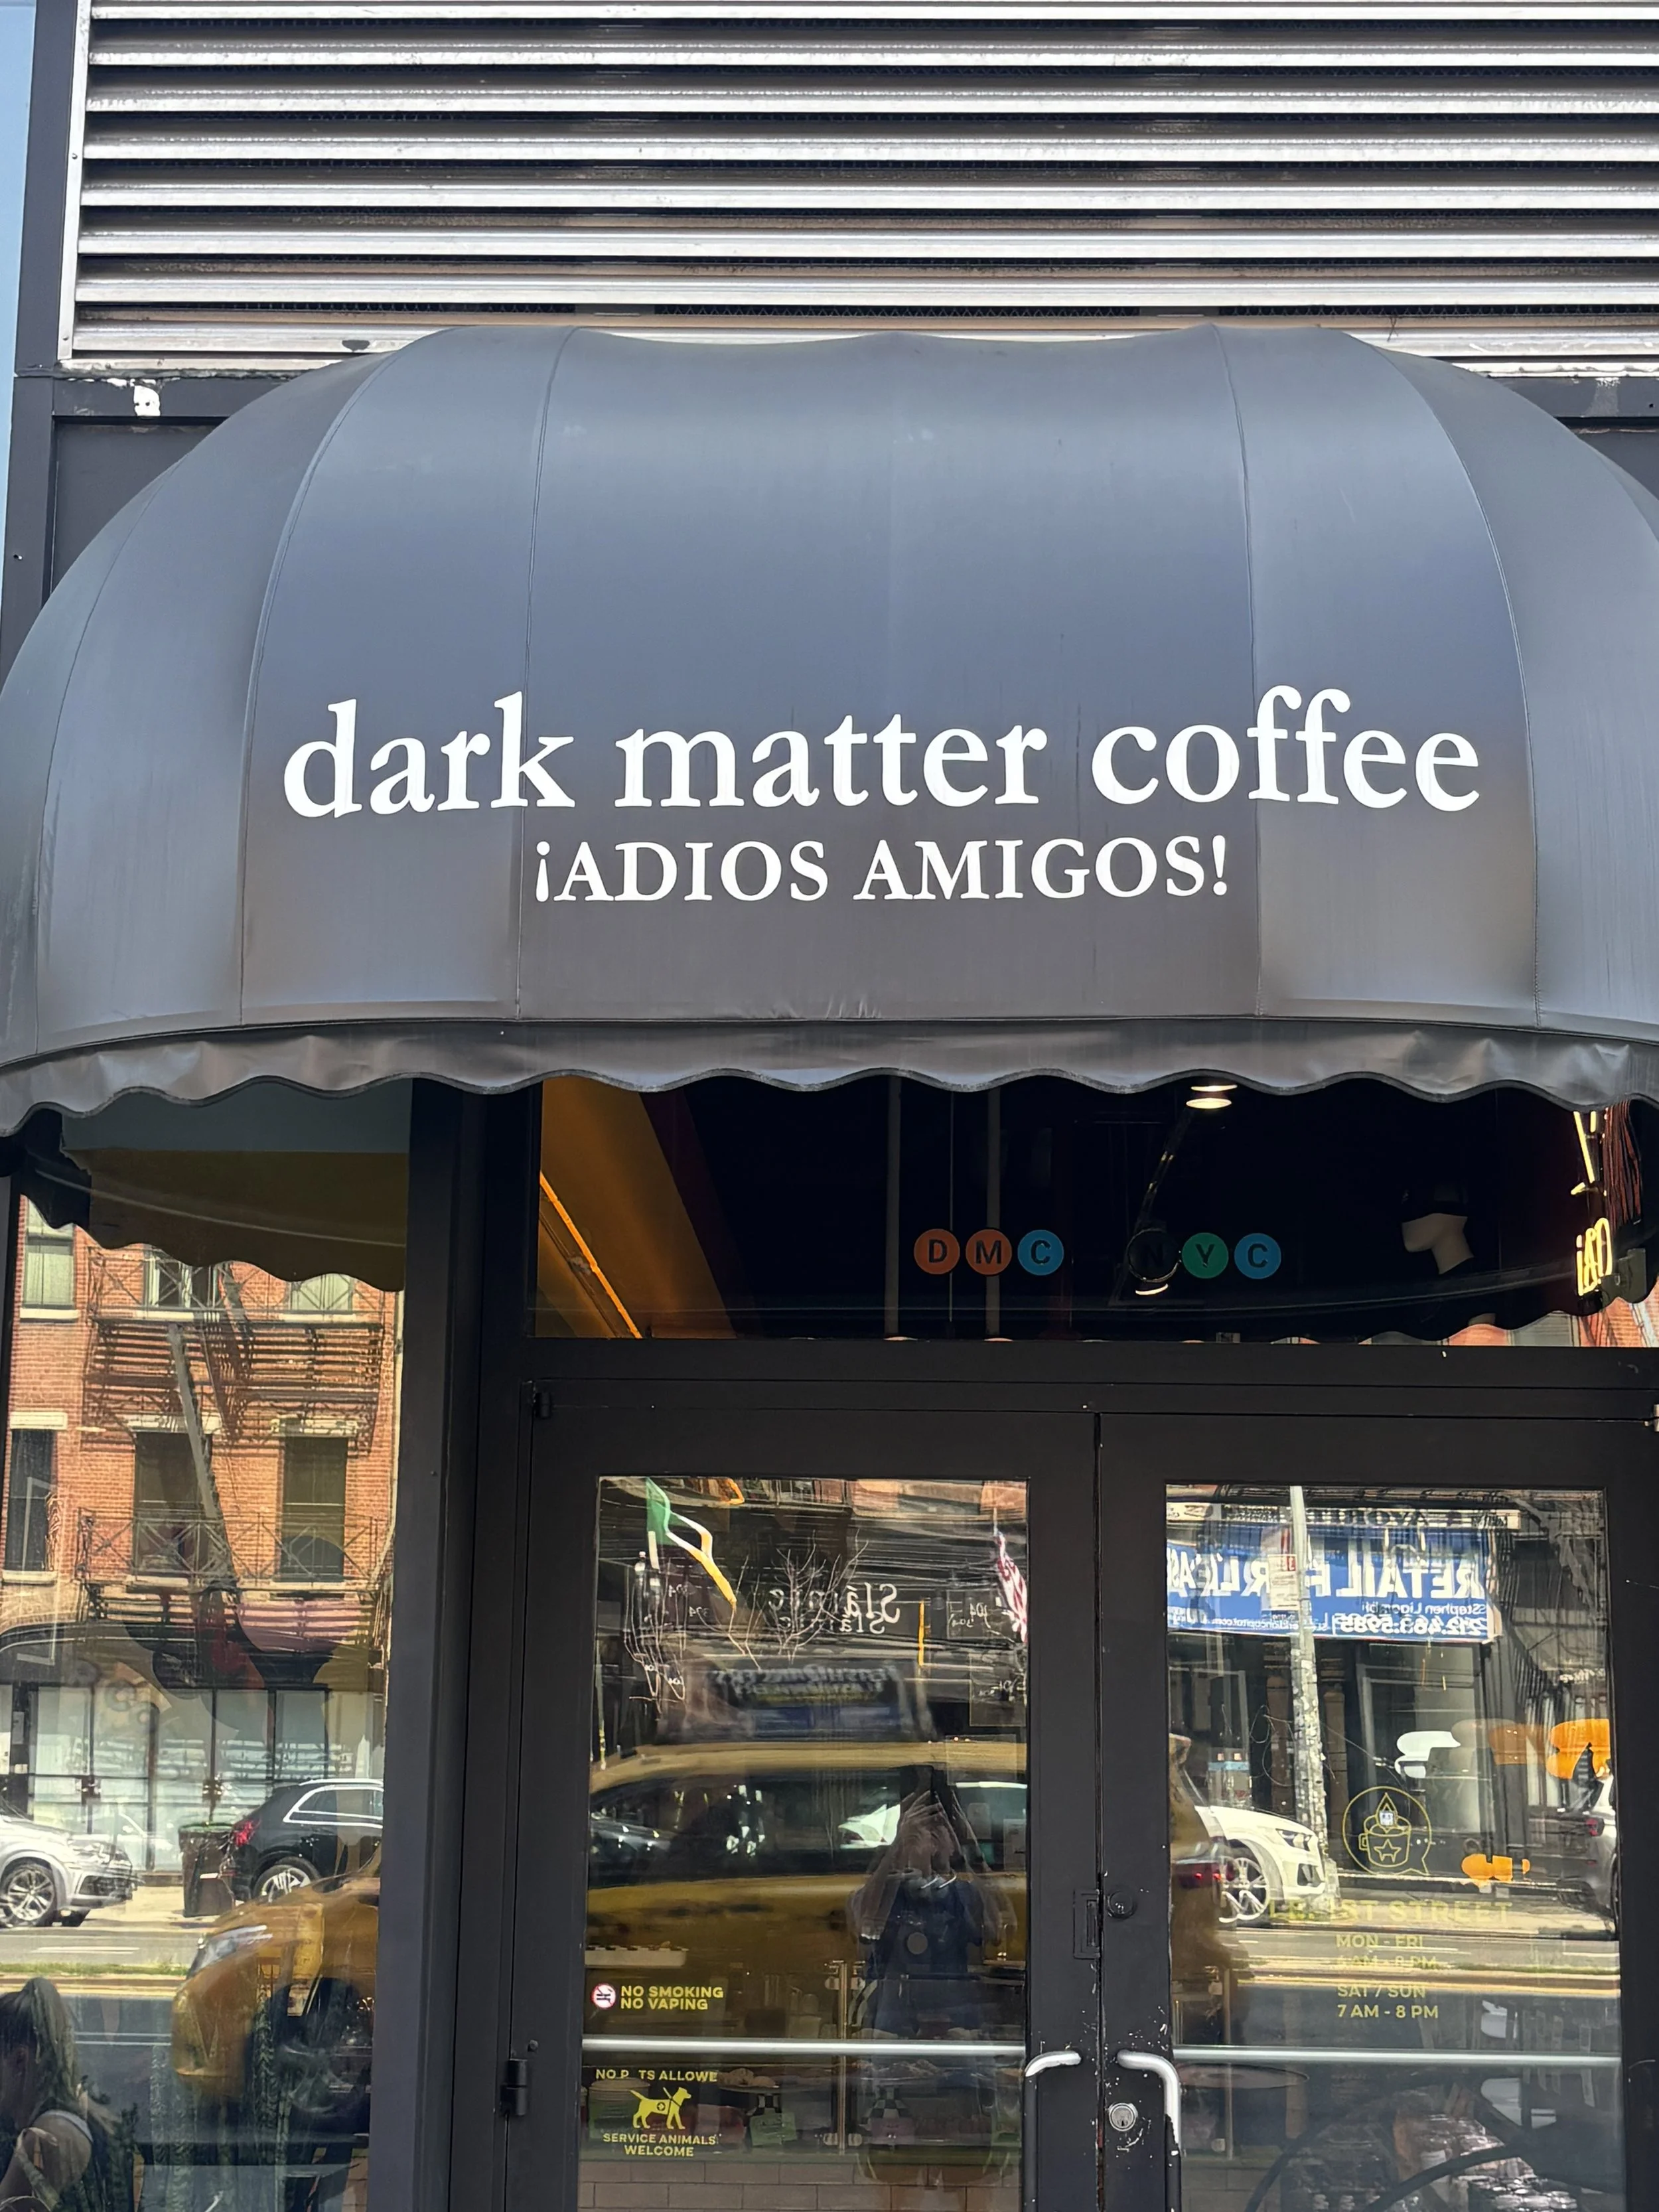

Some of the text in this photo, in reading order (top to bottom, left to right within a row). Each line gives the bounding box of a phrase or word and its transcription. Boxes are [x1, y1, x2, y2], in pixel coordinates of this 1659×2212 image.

[284, 685, 1480, 819] dark matter coffee
[536, 835, 1228, 903] ¡ADIOS AMIGOS!
[1388, 1900, 1513, 1923] STREET
[1336, 1935, 1378, 1948] MON
[1396, 1935, 1423, 1947] FRI
[620, 1985, 724, 1998] NO SMOKING
[1337, 1985, 1368, 1998] SAT
[1387, 1986, 1426, 1999] SUN
[620, 1998, 708, 2010] NO VAPING
[1336, 2004, 1348, 2018] 7
[1350, 2004, 1380, 2018] AM
[1395, 2004, 1406, 2019] 8
[1411, 2005, 1439, 2019] PM
[595, 2069, 616, 2079] NO
[603, 2133, 716, 2145] SERVICE ANIMALS
[624, 2145, 694, 2157] WELCOME
